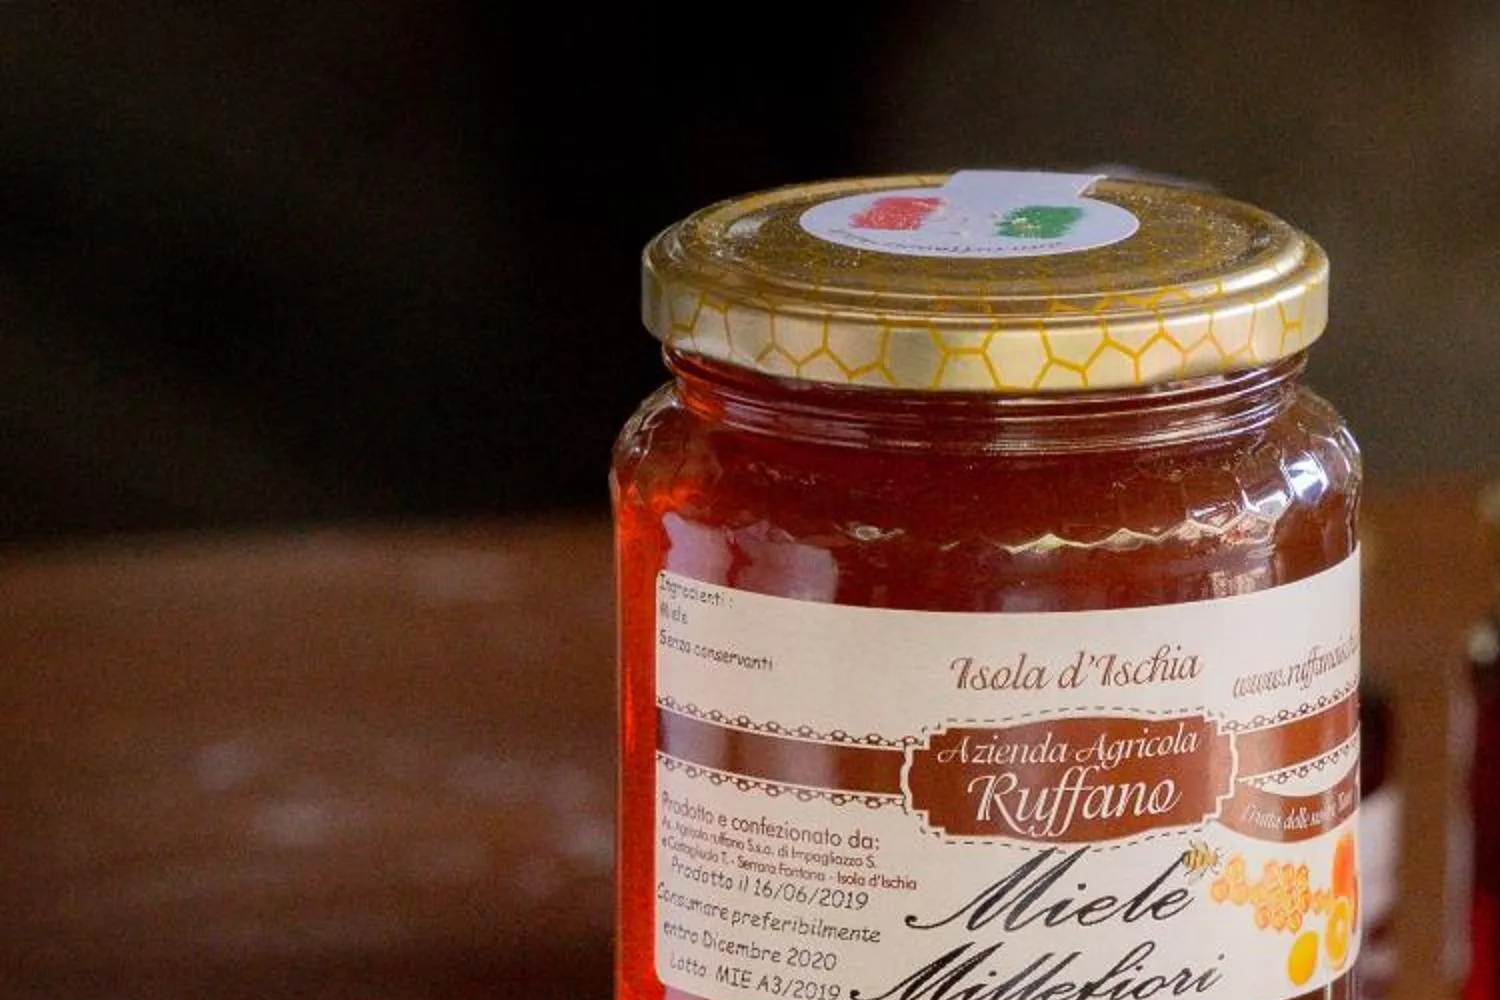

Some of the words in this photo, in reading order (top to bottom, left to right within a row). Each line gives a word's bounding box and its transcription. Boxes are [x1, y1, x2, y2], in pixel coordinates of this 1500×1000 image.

[950, 653, 1051, 690] Isola
[1058, 645, 1203, 688] d'Ischia
[937, 732, 1068, 765] Azienda
[1075, 722, 1199, 768] Agricola
[967, 763, 1181, 837] Ruffano
[731, 816, 842, 847] confezionato
[754, 878, 869, 911] 16/06/2019
[904, 845, 1196, 934] Miele
[732, 910, 881, 943] preferibilmente
[702, 927, 781, 963] Dicembre
[787, 948, 837, 972] 2020
[716, 964, 750, 989] MIE
